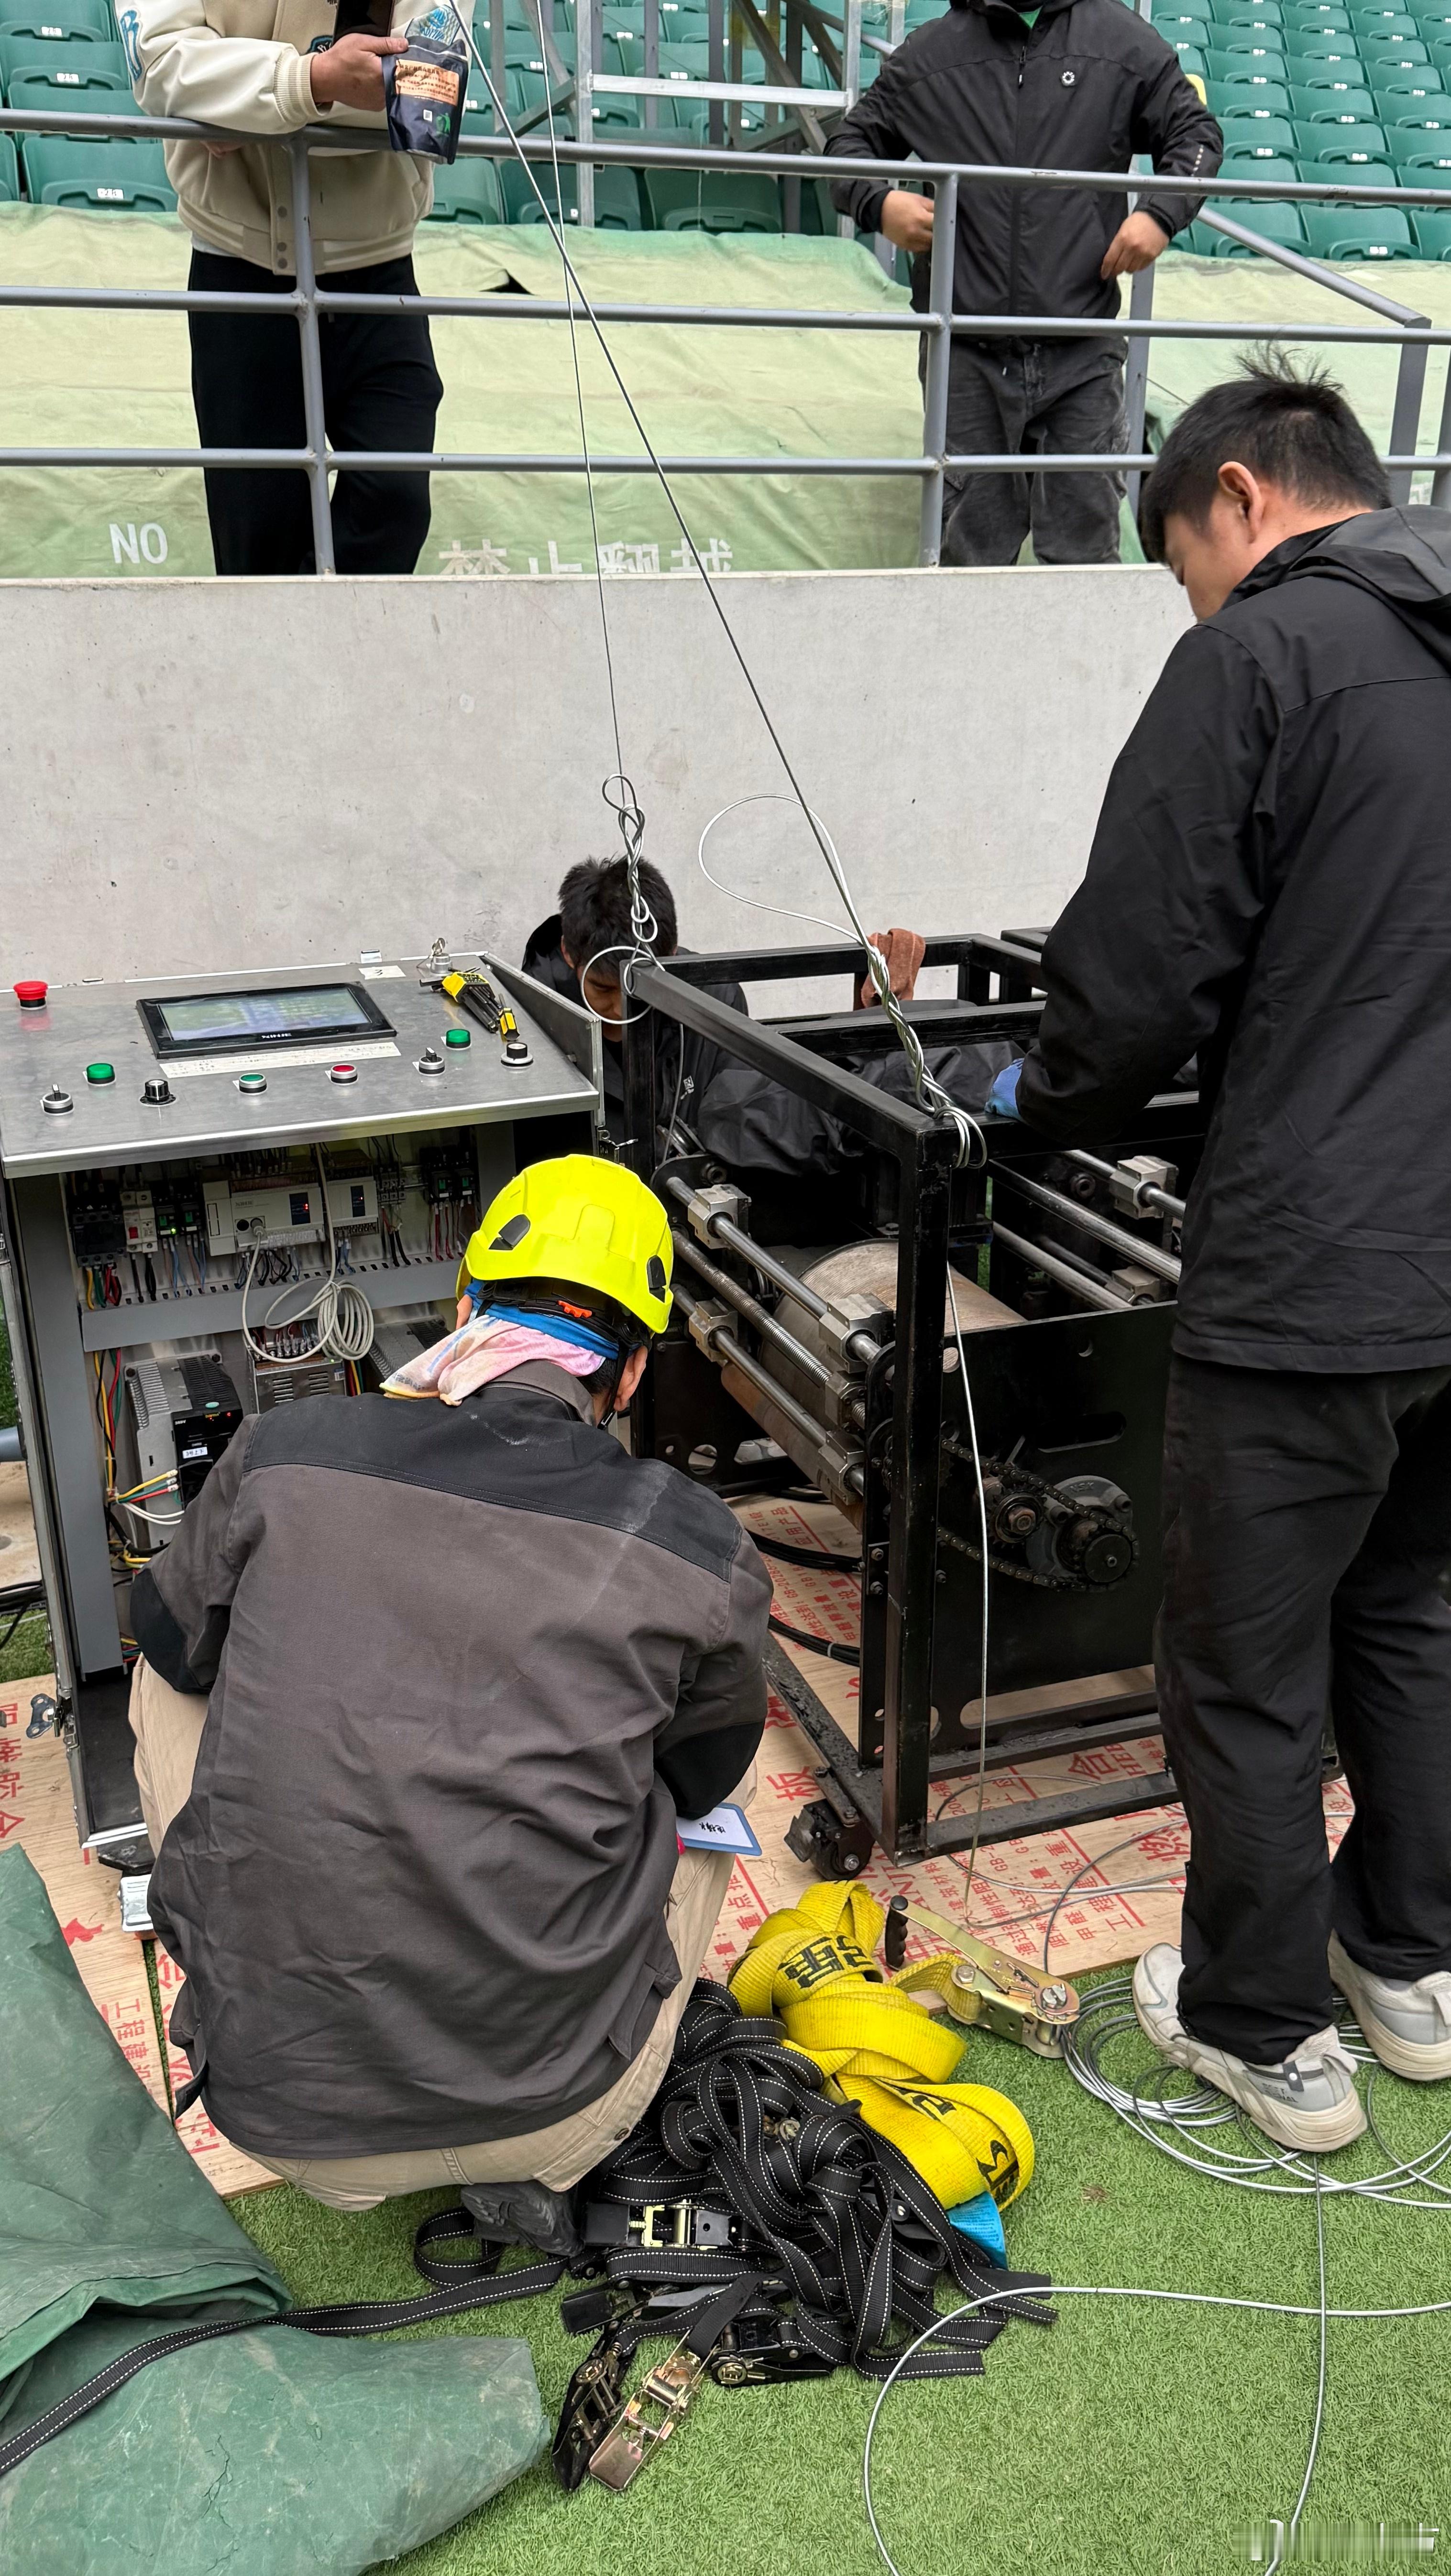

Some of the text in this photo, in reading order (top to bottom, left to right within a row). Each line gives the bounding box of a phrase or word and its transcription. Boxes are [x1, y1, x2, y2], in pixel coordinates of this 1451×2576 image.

[109, 523, 168, 564] NO
[770, 1507, 813, 1545] 应用产品
[767, 1766, 822, 1801] 板
